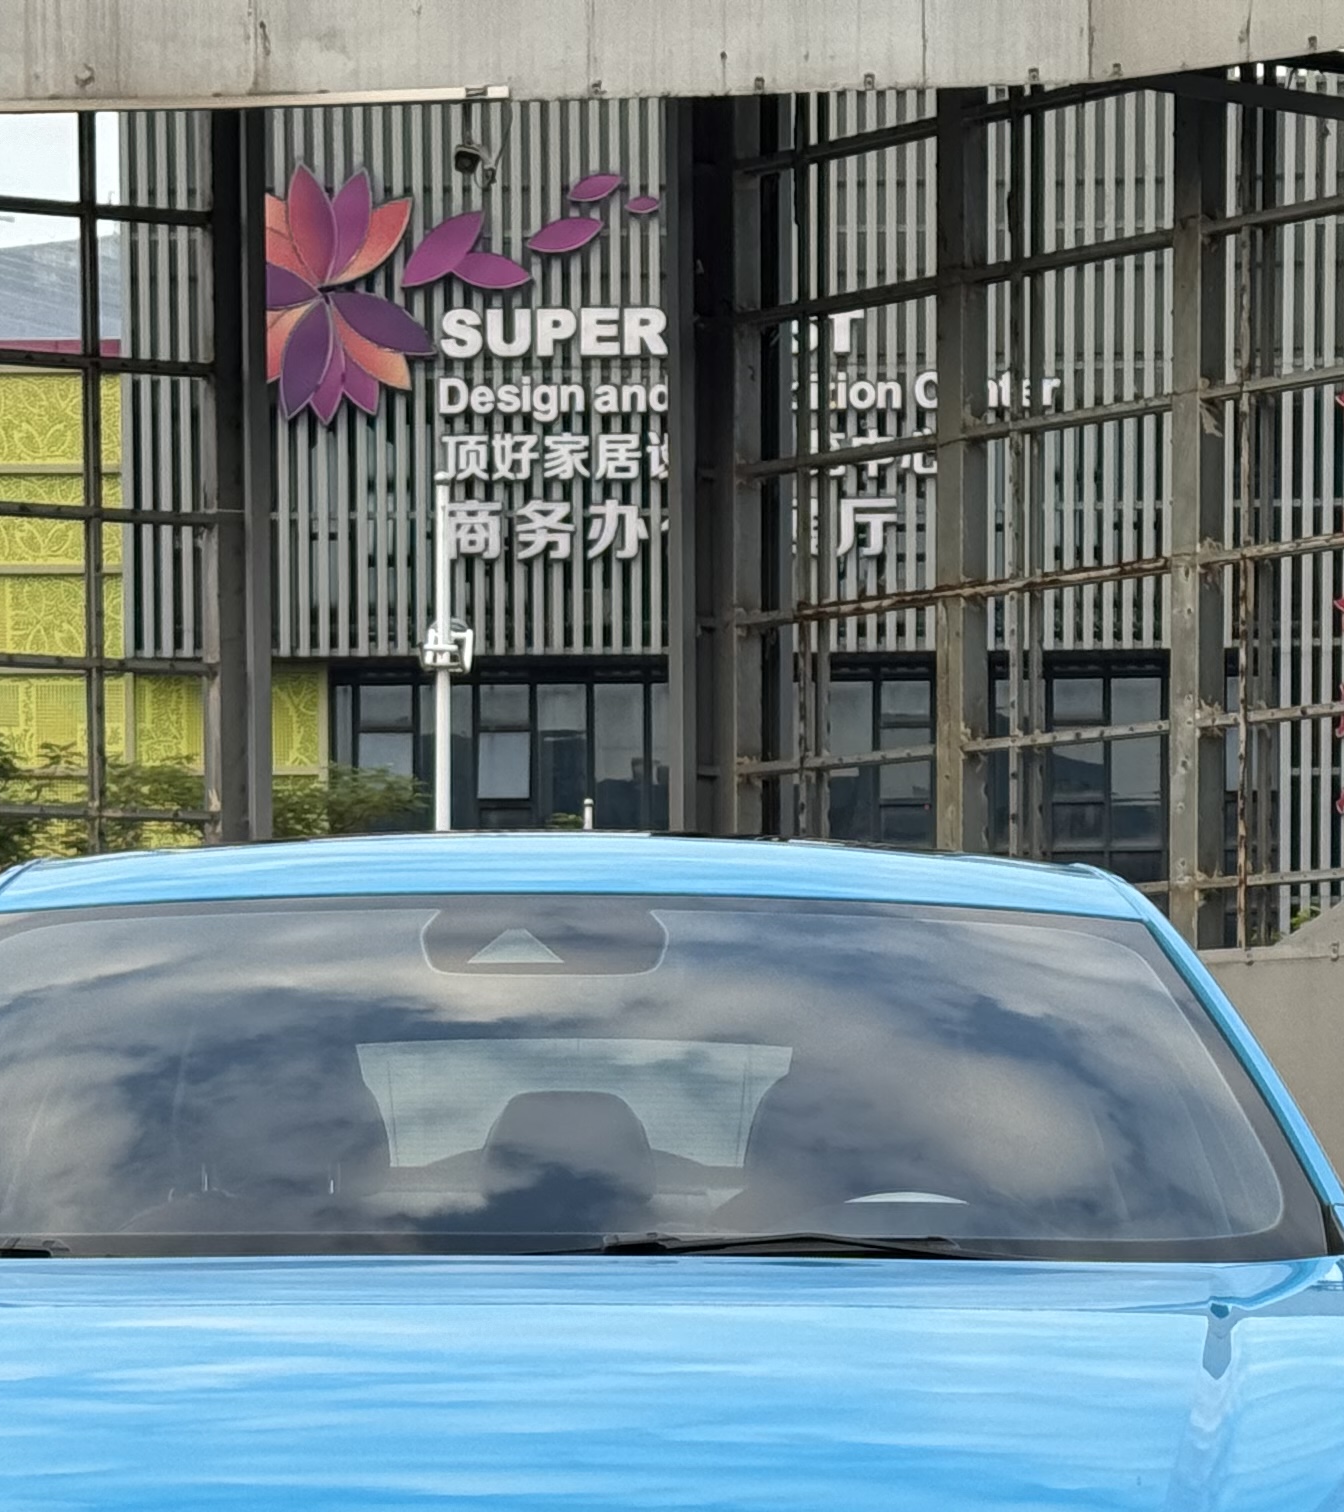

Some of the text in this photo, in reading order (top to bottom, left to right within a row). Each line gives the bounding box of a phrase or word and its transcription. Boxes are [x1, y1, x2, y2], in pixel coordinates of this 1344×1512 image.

[440, 308, 669, 358] SUPER
[439, 375, 585, 422] Design
[593, 374, 669, 413] and
[447, 499, 669, 560] 商务办
